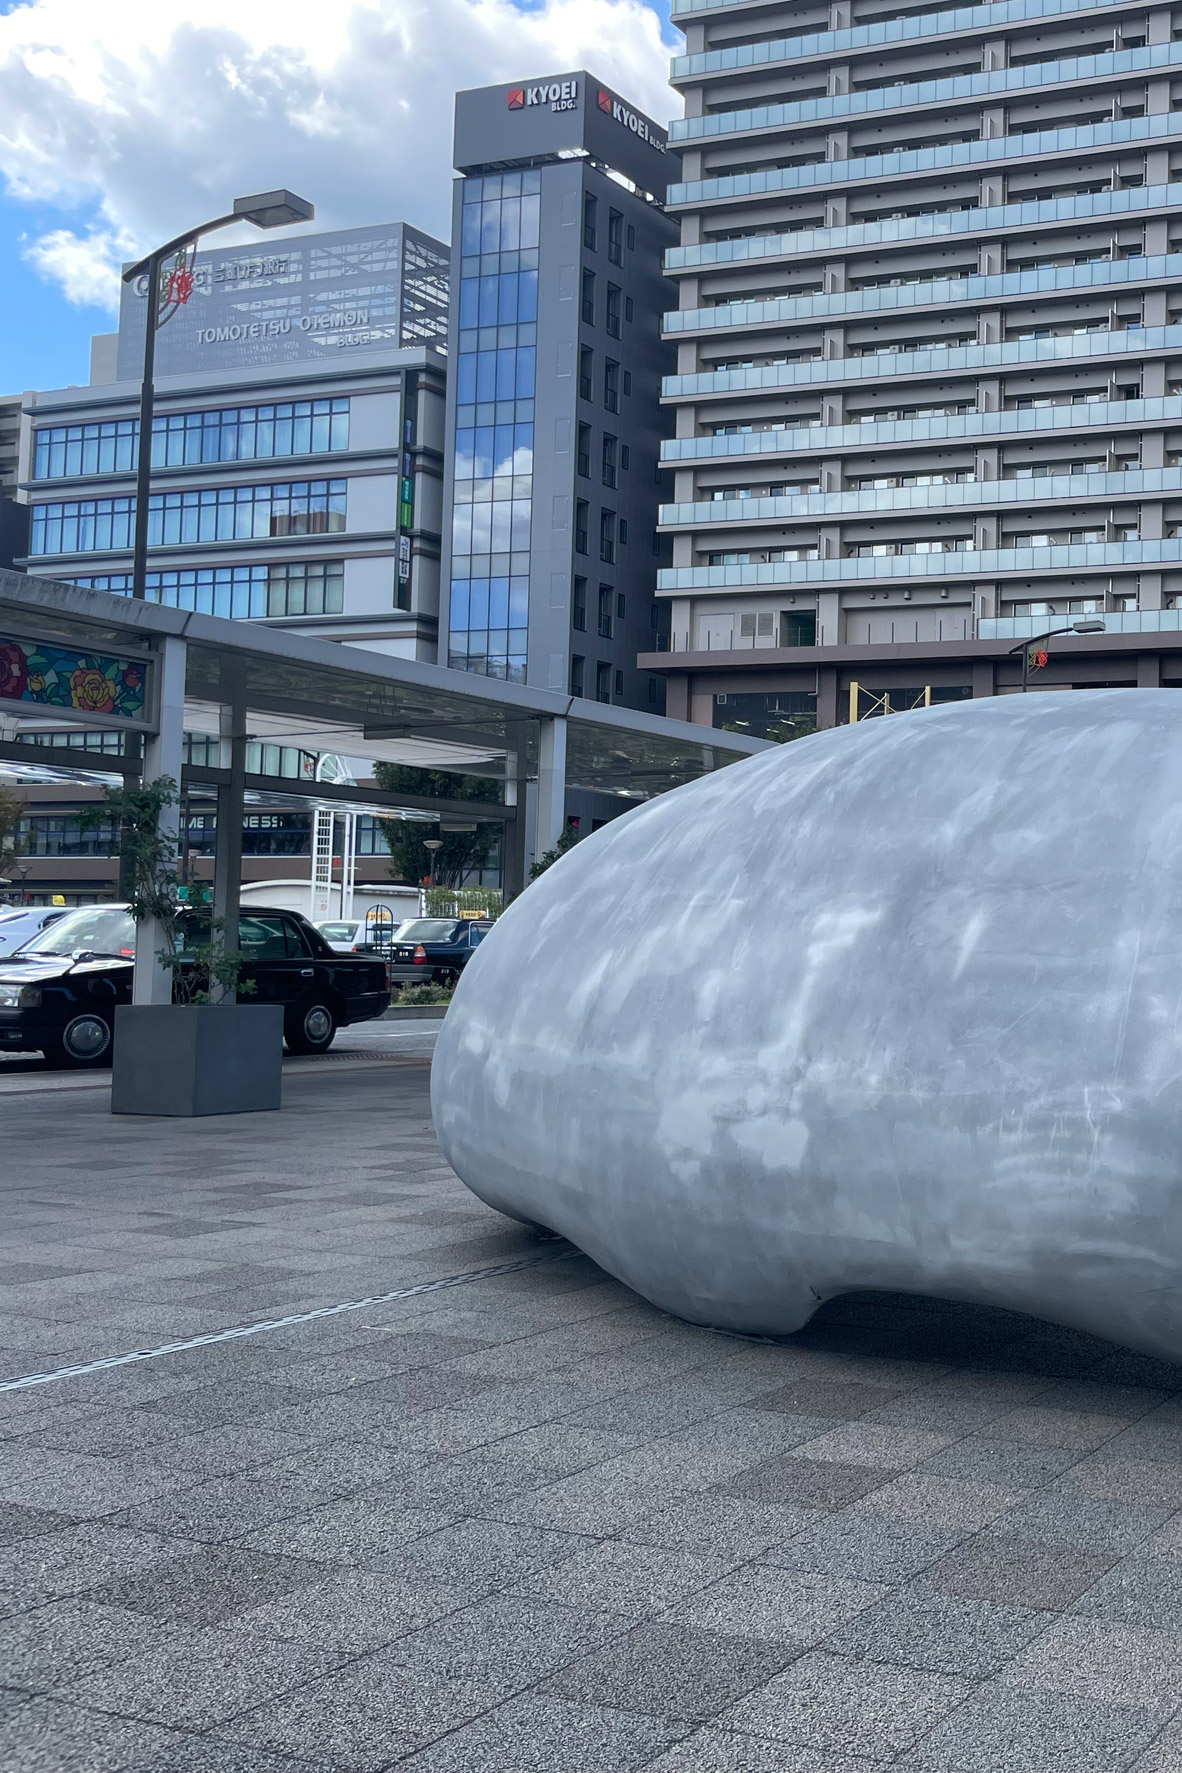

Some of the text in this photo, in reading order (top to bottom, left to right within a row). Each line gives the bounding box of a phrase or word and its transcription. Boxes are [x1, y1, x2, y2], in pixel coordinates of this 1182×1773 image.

[527, 80, 578, 106] KYOEI
[551, 99, 577, 112] BLDG.
[612, 101, 667, 155] KYOEI BLDG.
[196, 308, 370, 345] TOMOTETSU OTEMON
